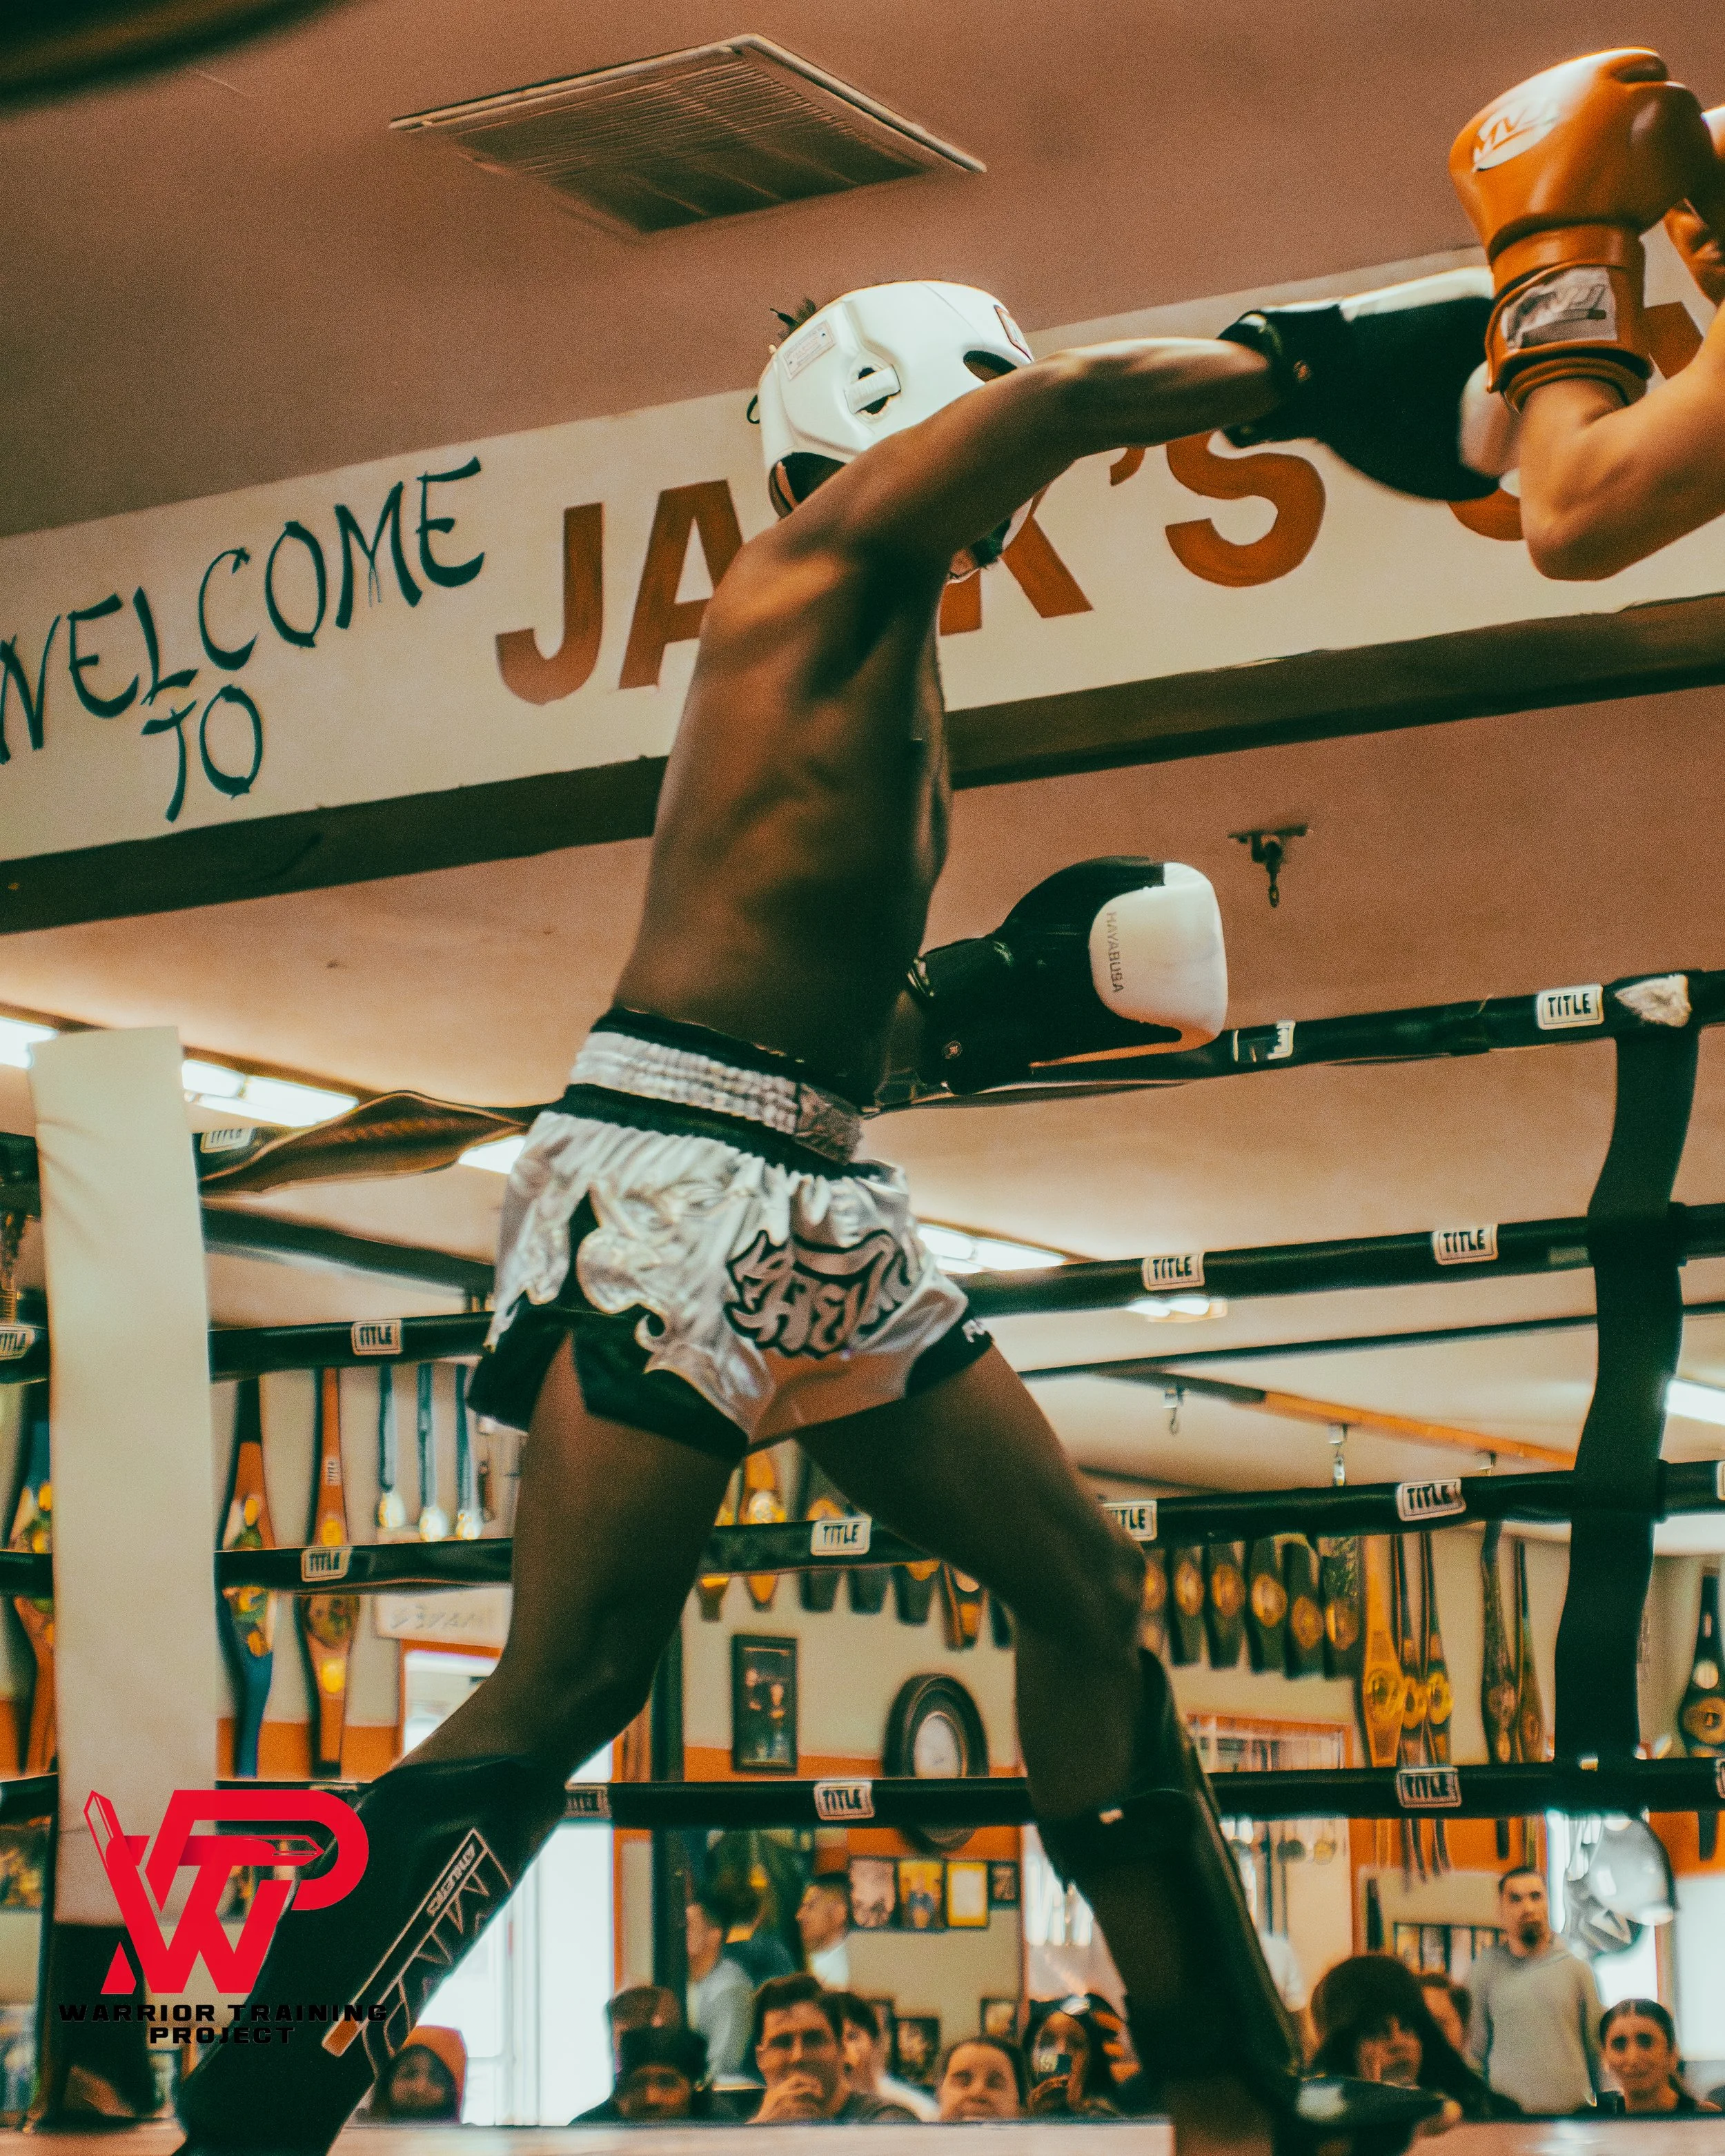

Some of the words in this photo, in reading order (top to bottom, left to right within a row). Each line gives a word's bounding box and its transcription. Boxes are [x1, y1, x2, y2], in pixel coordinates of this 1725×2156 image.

[0, 456, 484, 759] WELCOME
[141, 684, 263, 822] TO
[1106, 911, 1124, 992] HAYABUSA
[1548, 993, 1591, 1018] TITLE
[1443, 1229, 1486, 1253] TITLE
[1153, 1256, 1192, 1280] TITLE
[359, 1325, 392, 1345] TITLE
[823, 1524, 859, 1544] TITLE
[822, 1789, 862, 1811] TITLE
